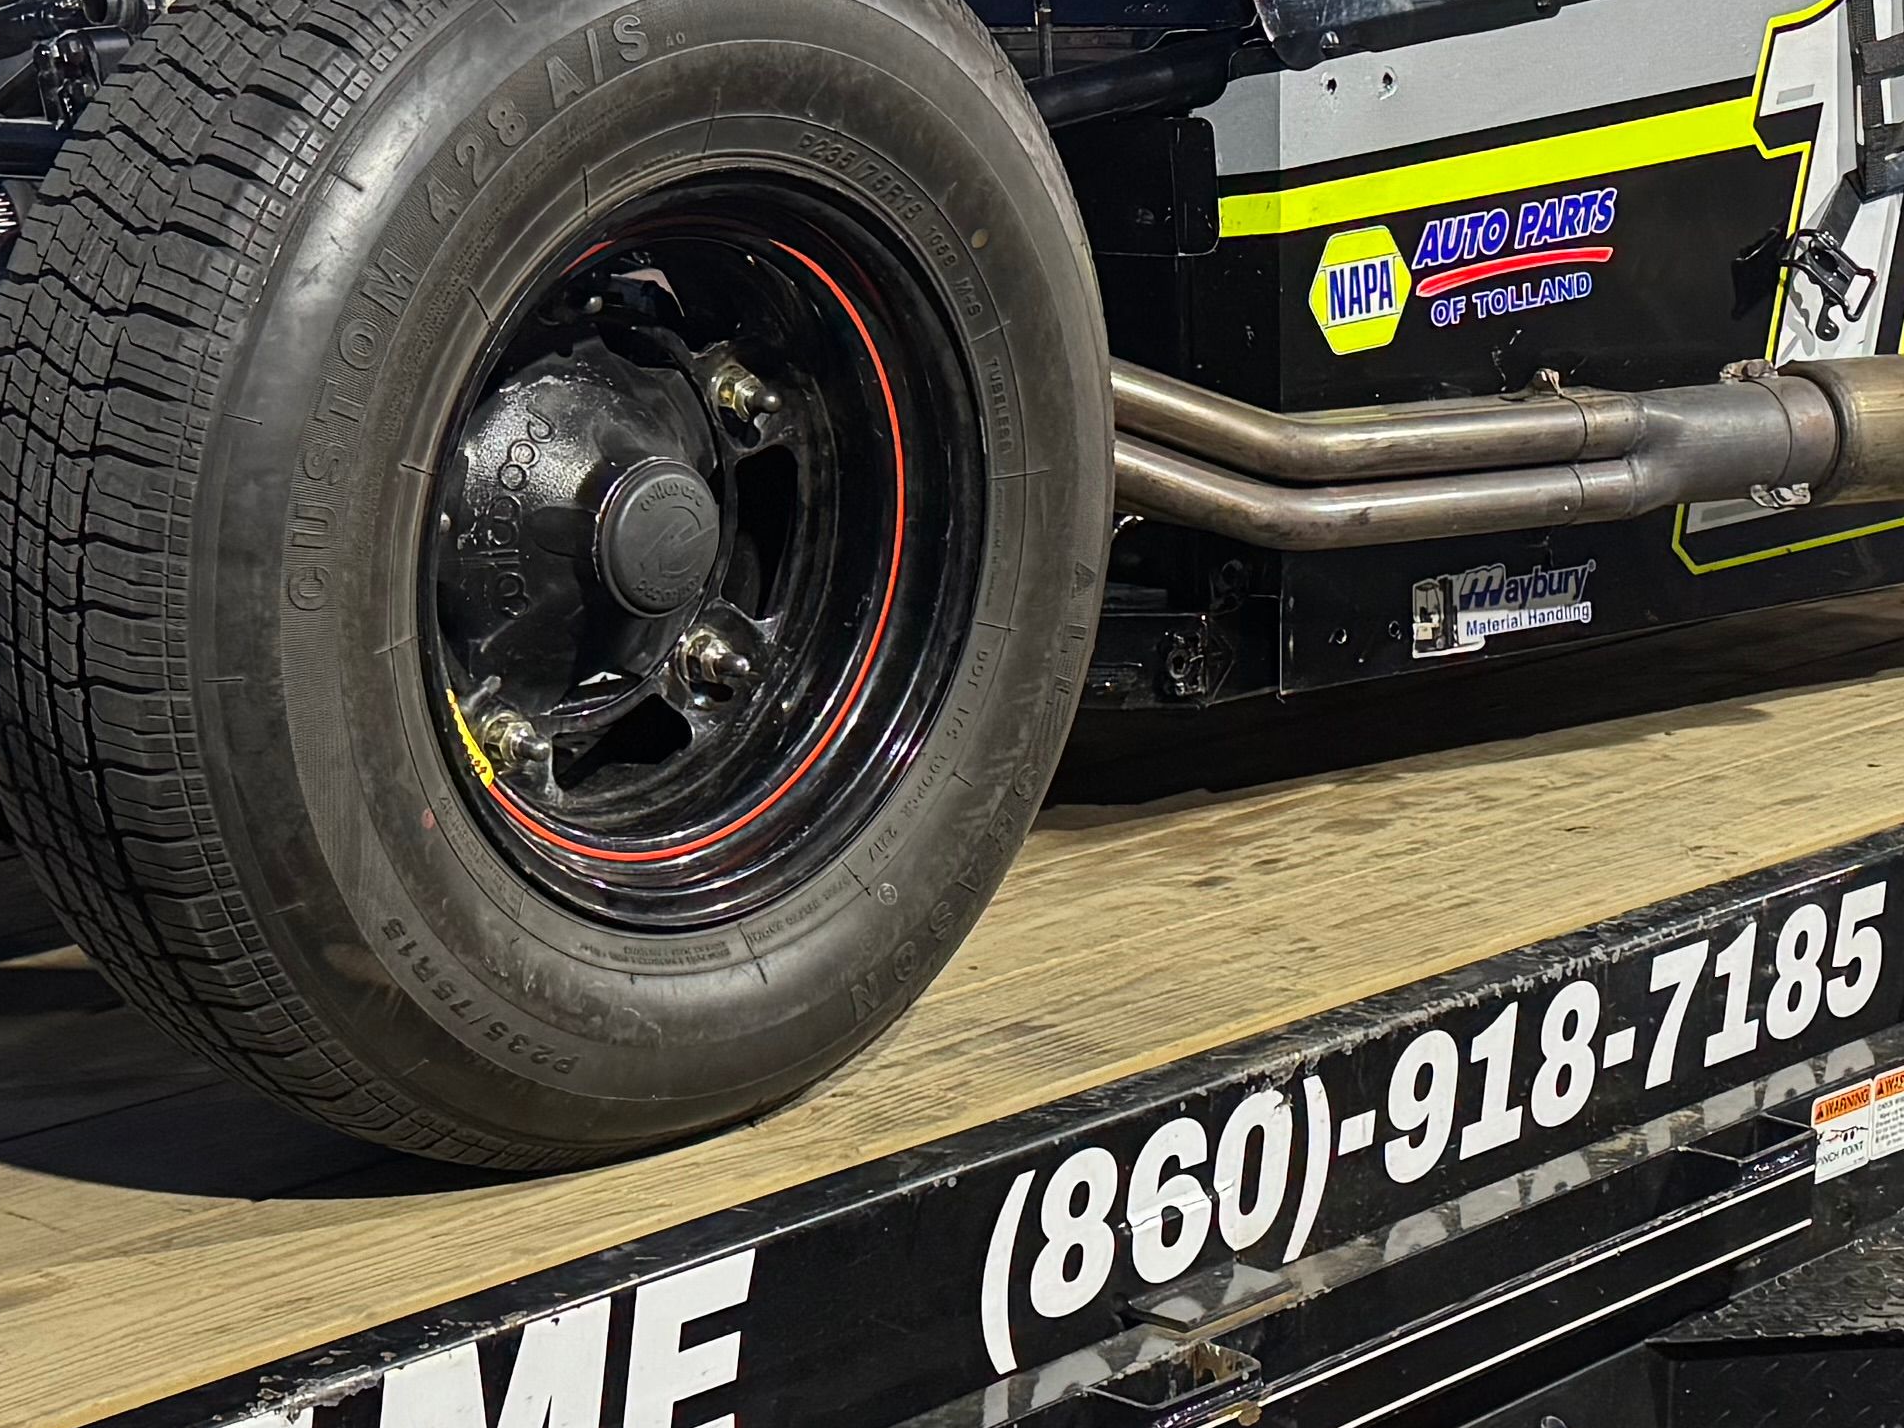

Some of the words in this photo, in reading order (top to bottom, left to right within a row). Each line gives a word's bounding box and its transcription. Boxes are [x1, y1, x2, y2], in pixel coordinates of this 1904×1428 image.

[286, 249, 418, 614] CUSTOM
[423, 97, 530, 227] 428
[545, 12, 649, 110] A/S
[1328, 259, 1394, 321] NAPA
[1412, 208, 1509, 270] AUTO
[1514, 187, 1619, 250] PARTS
[1430, 295, 1466, 327] OF
[1472, 272, 1593, 319] TOLLAND
[1466, 612, 1524, 637] Material
[1527, 602, 1591, 625] Handling
[849, 760, 1042, 1023] SEASON
[380, 917, 582, 1075] P235/75R15
[981, 880, 1889, 1375] (860)-918-7185
[1824, 1087, 1870, 1117] WARNING
